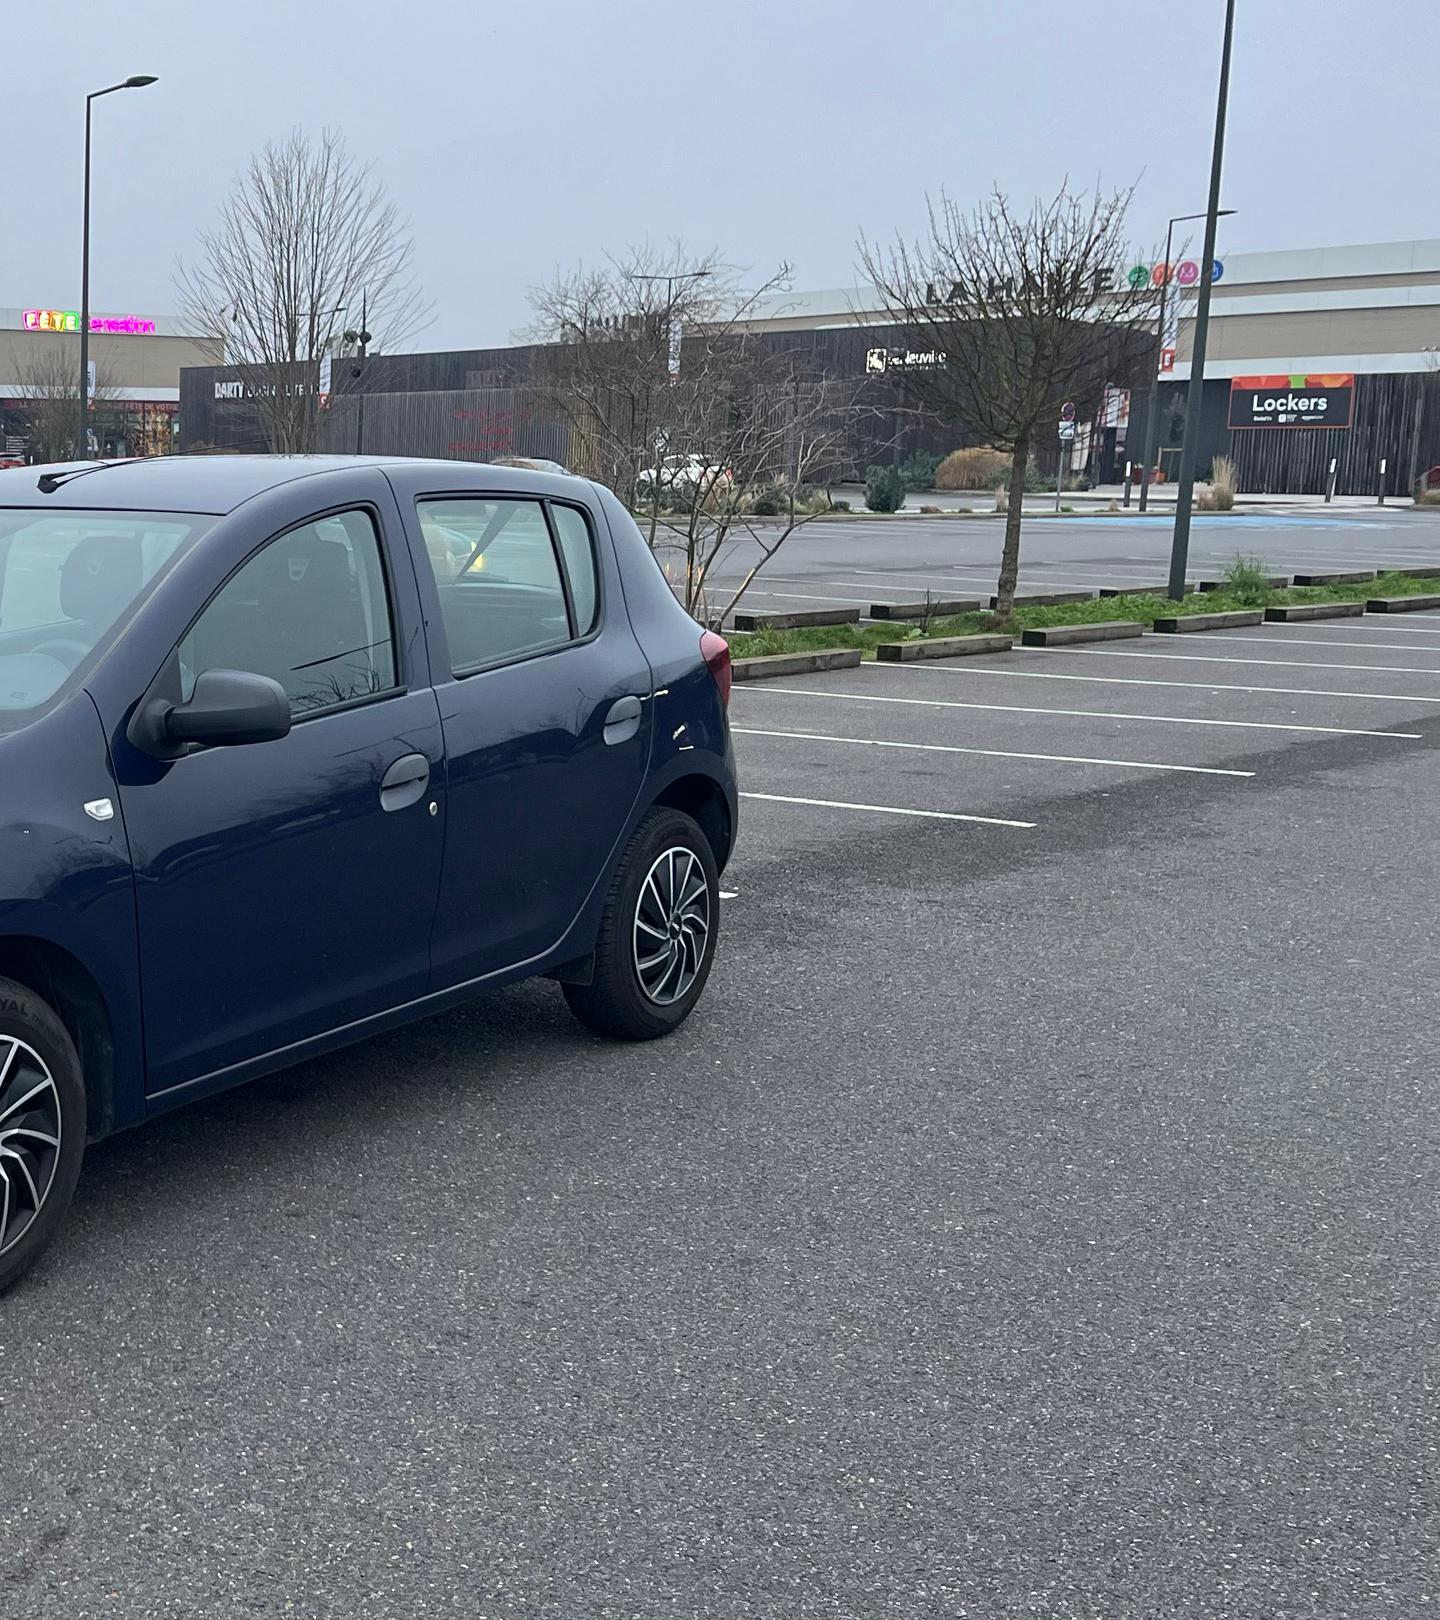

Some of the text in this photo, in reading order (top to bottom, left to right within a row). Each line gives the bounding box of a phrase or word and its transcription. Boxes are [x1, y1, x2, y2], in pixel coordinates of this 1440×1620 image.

[926, 281, 969, 304] LA
[89, 315, 155, 333] ensation
[215, 382, 244, 398] DARTY
[1253, 393, 1327, 411] Lockers
